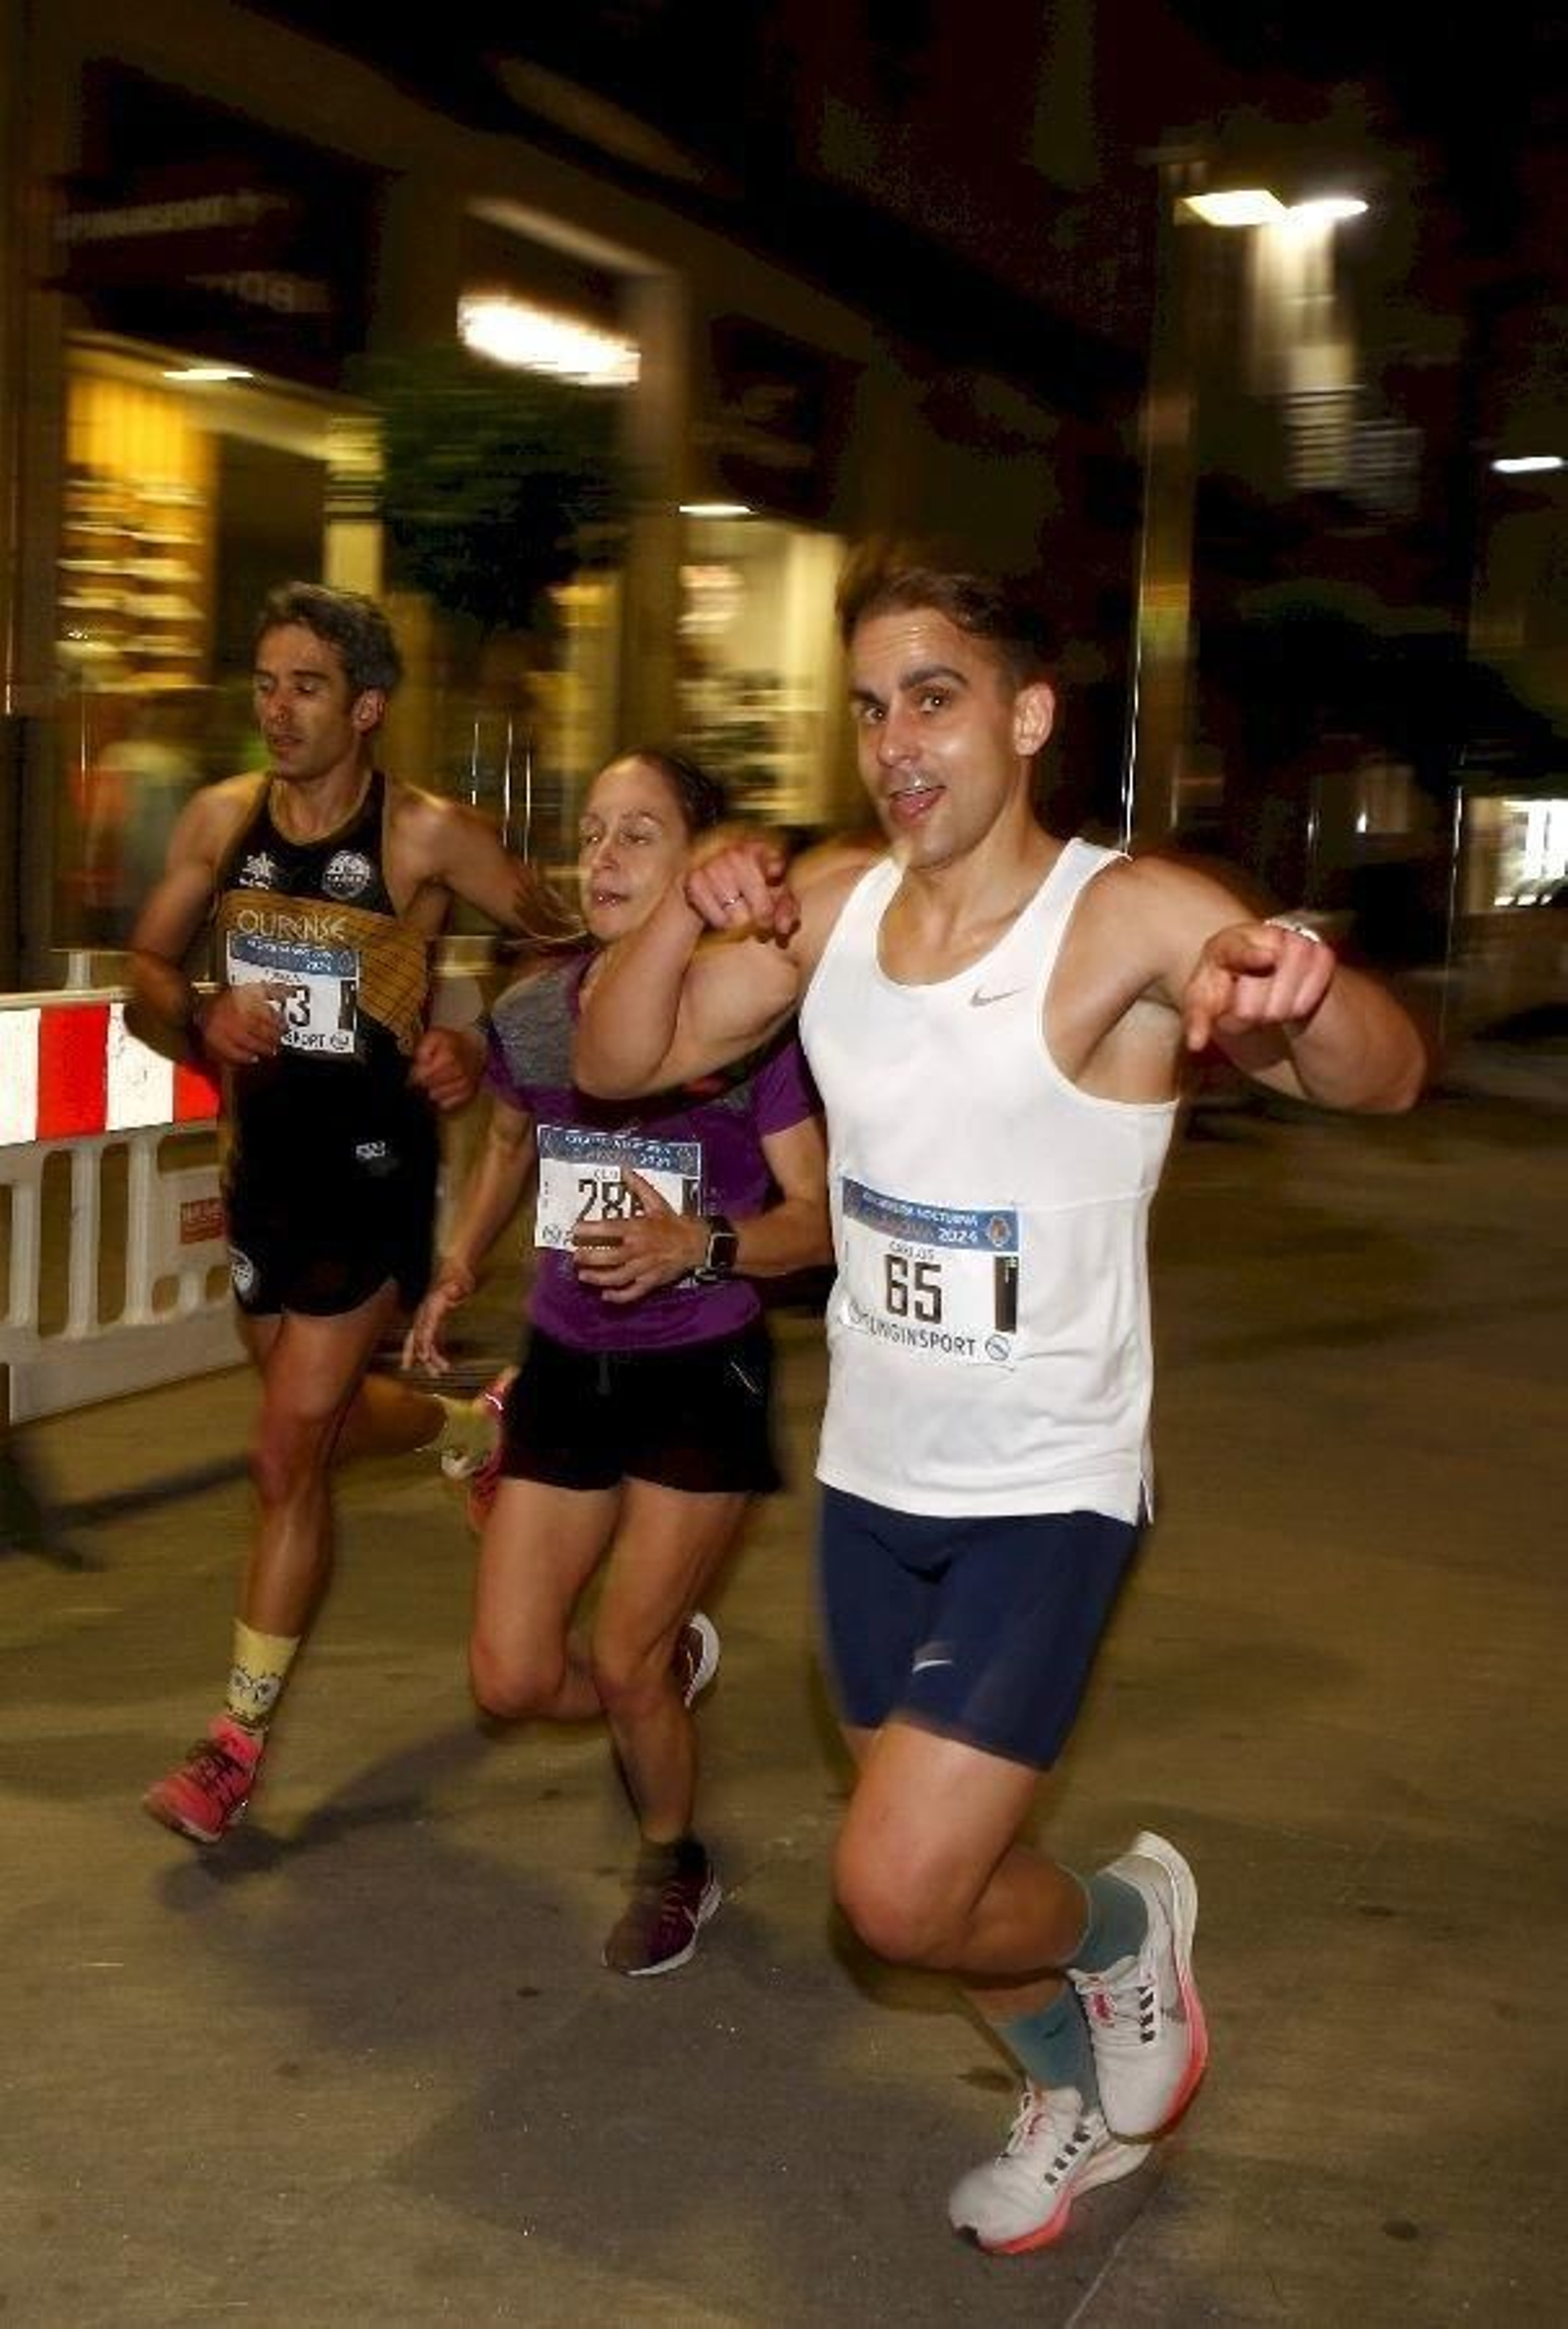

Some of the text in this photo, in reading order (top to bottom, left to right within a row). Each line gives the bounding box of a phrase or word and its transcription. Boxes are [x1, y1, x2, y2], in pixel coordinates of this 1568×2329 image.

[278, 984, 311, 1027] 3
[938, 1227, 979, 1245] 2024
[885, 1254, 942, 1324] 65
